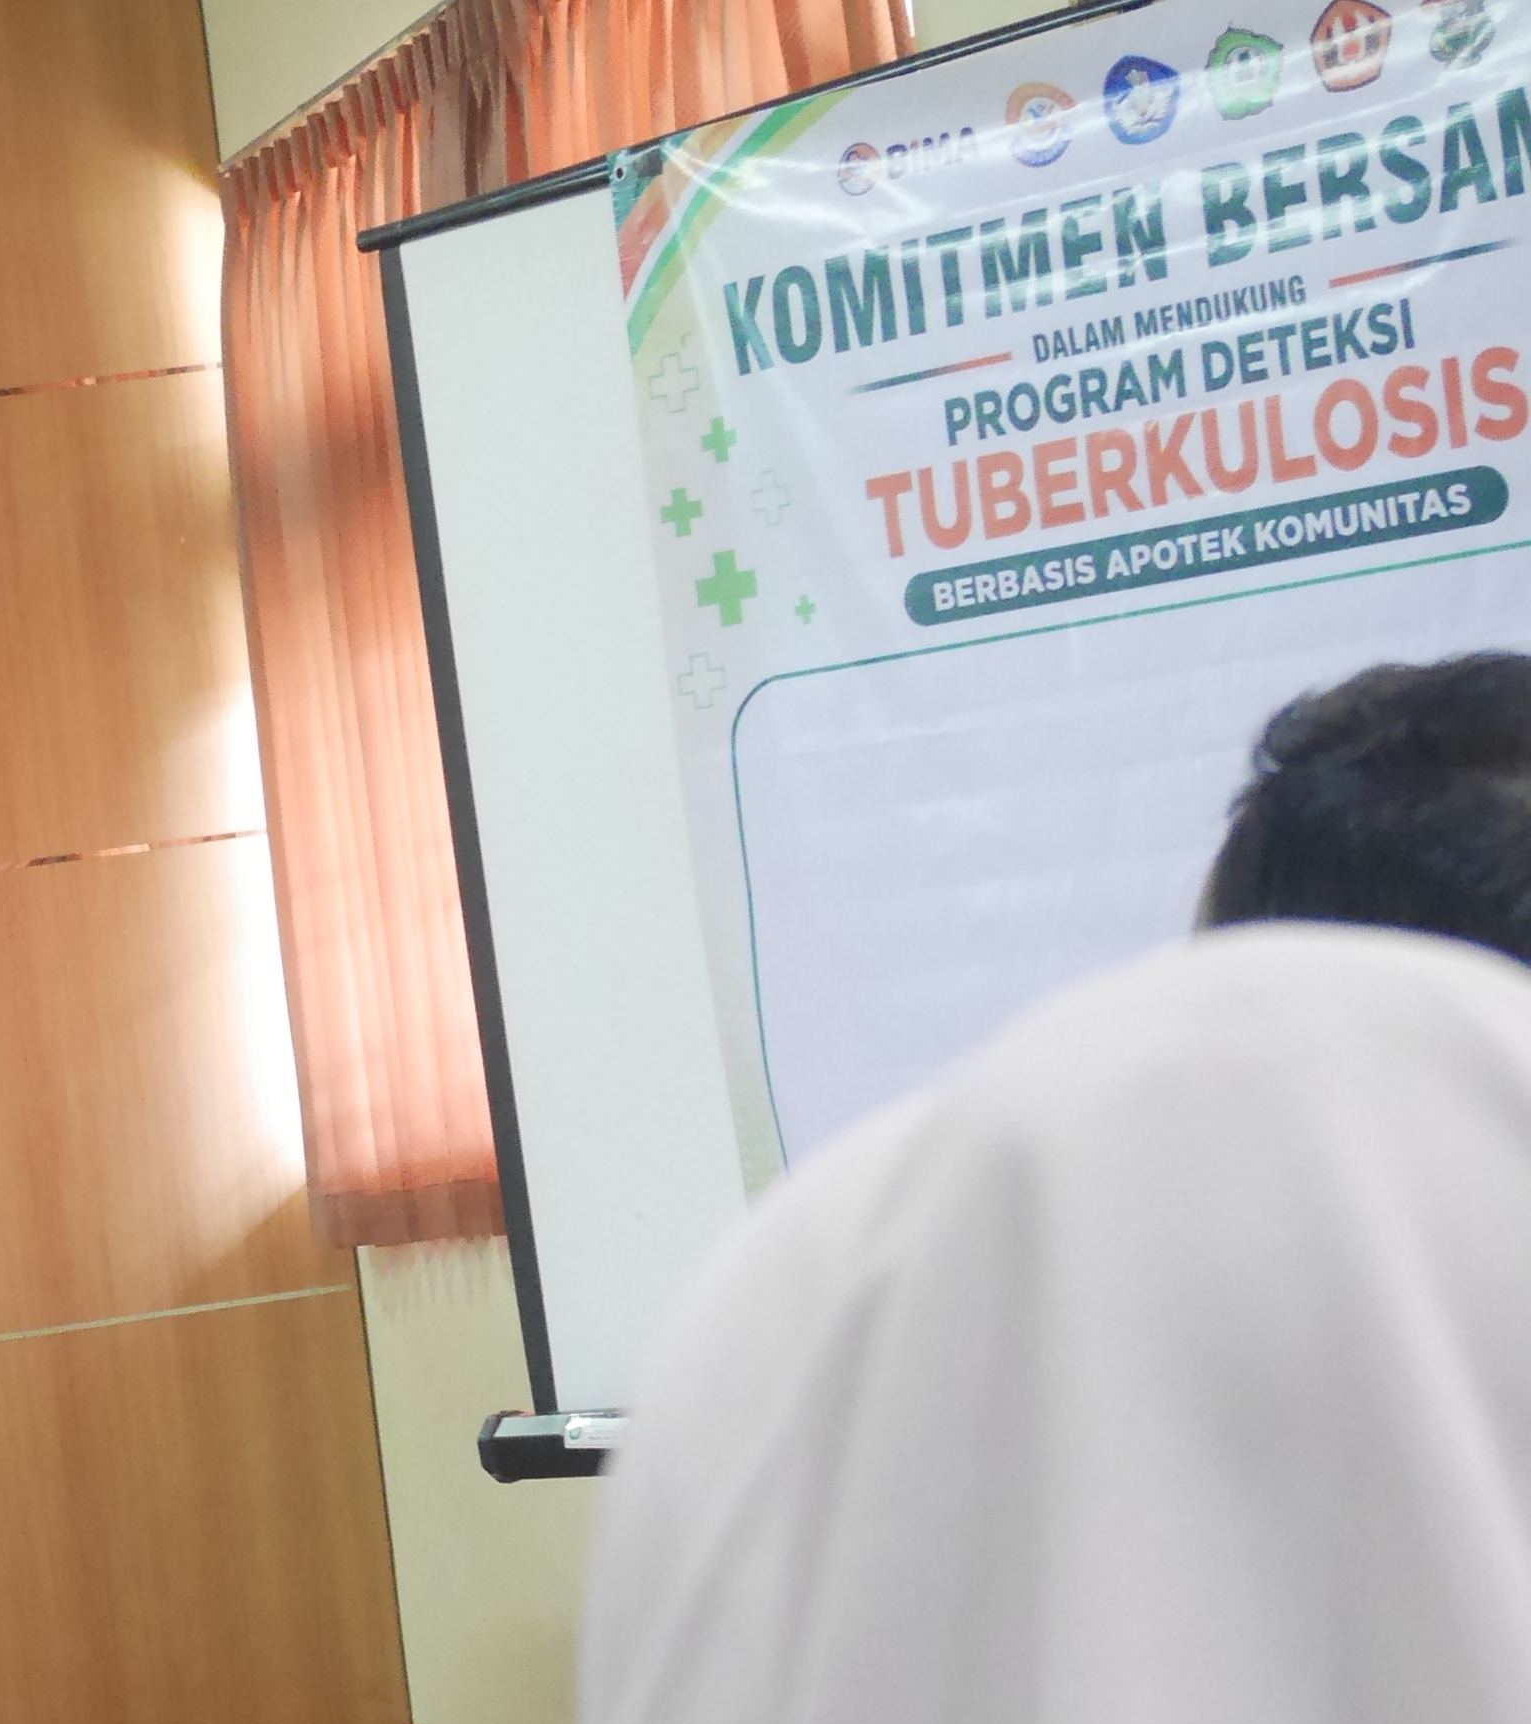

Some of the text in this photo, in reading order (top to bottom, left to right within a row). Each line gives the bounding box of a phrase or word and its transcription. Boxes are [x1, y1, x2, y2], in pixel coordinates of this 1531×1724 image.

[724, 181, 1176, 375] KOMITMEN
[1032, 276, 1307, 363] DALAM MENDUKUNG
[944, 298, 1416, 446] PROGRAM DETEKSI
[866, 346, 1530, 559] TUBERKULOSIS
[932, 483, 1472, 612] BERBASIS APOTEK KOMUNITAS
